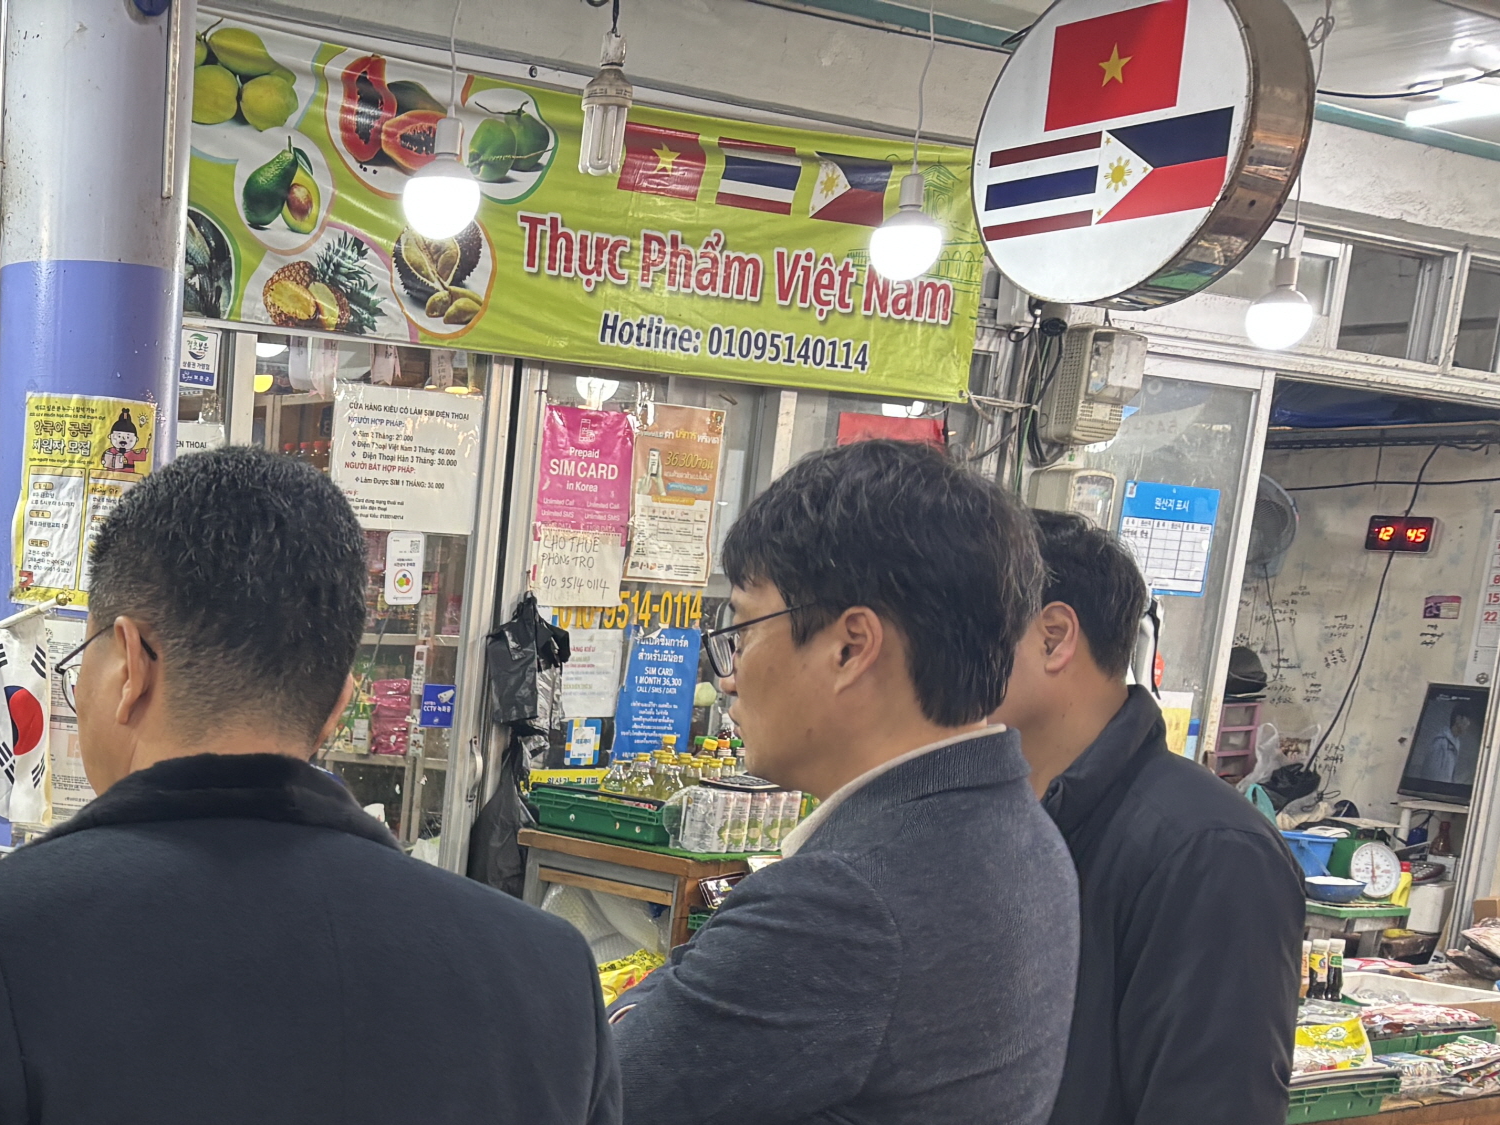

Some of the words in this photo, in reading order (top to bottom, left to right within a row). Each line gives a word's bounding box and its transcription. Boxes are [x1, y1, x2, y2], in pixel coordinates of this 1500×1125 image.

[519, 214, 628, 289] Thực
[641, 231, 760, 300] Phẩm
[776, 250, 855, 320] Việt
[863, 263, 951, 323] Nam
[600, 314, 700, 354] Hotline:
[708, 326, 869, 371] 01095140114
[34, 420, 66, 437] 한국어
[68, 421, 93, 437] 공부
[32, 438, 65, 455] 지원자
[67, 440, 90, 456] 모집
[569, 447, 599, 459] Prepaid
[437, 458, 457, 467] 30.000
[550, 459, 574, 476] SIM
[577, 462, 618, 480] CARD
[566, 481, 573, 490] in
[575, 482, 598, 492] Korea
[1154, 497, 1175, 511] 원산지
[1175, 500, 1189, 512] 표시
[1379, 526, 1394, 541] 12
[1407, 528, 1426, 542] 45
[543, 535, 566, 550] CHO
[572, 556, 594, 571] TRỌ
[560, 577, 584, 593] 9514
[587, 578, 610, 600] 0114
[1488, 592, 1500, 604] 15
[558, 590, 703, 629] 010-9514-0114
[1484, 611, 1498, 622] 22
[645, 667, 656, 675] SIM
[658, 667, 674, 676] CARD
[639, 676, 661, 685] MONTH
